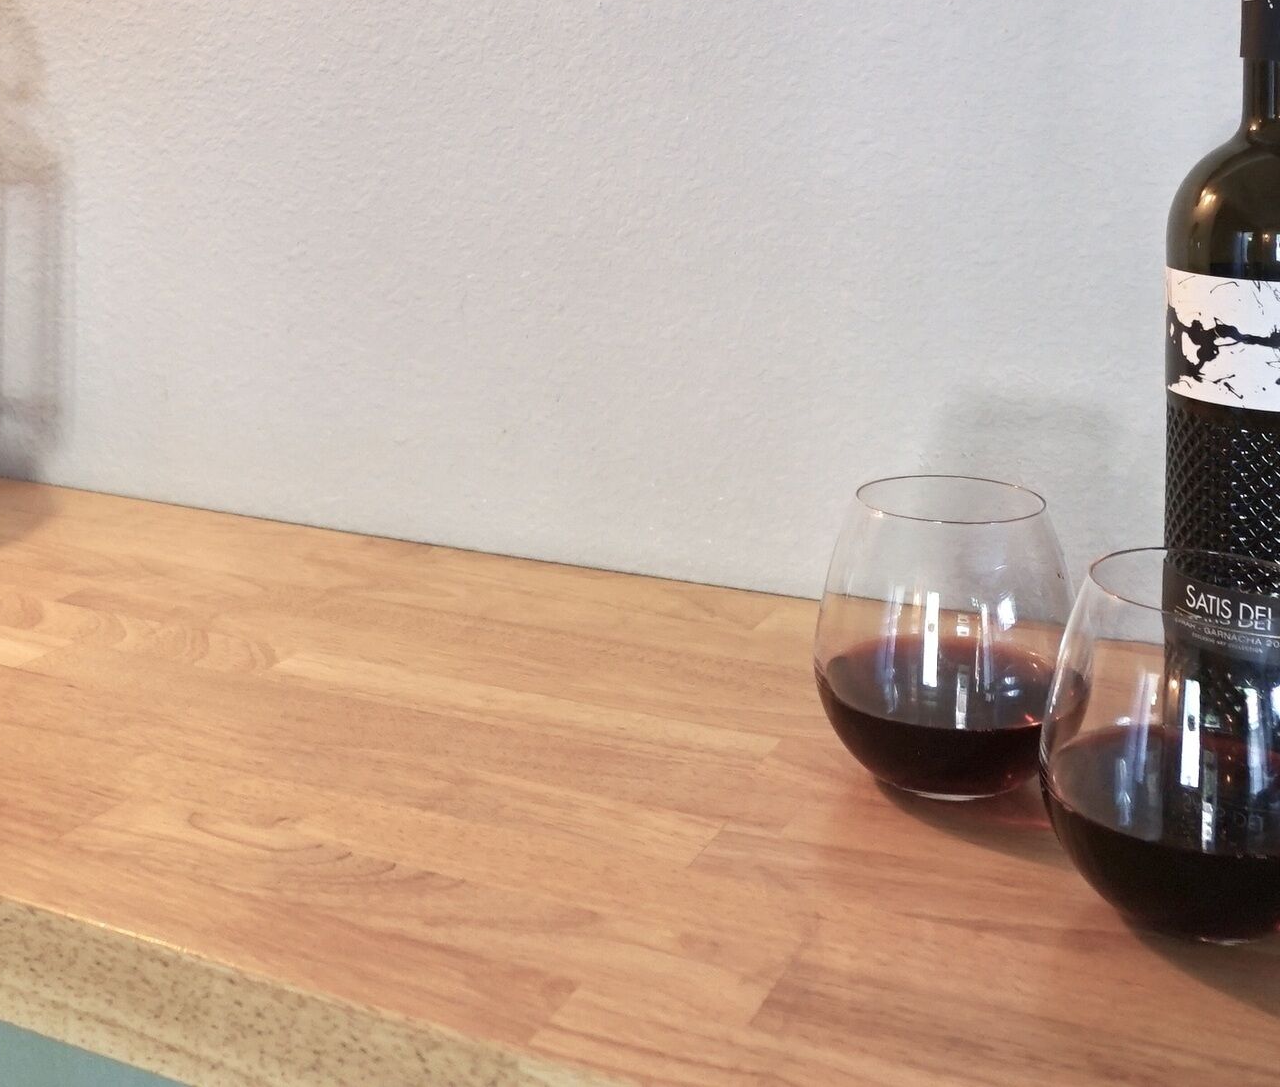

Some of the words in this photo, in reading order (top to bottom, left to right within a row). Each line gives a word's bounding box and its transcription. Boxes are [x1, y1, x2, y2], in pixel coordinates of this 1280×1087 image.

[1185, 584, 1232, 619] SATIS
[1238, 603, 1272, 631] DEI
[1204, 628, 1262, 646] GARNACHA
